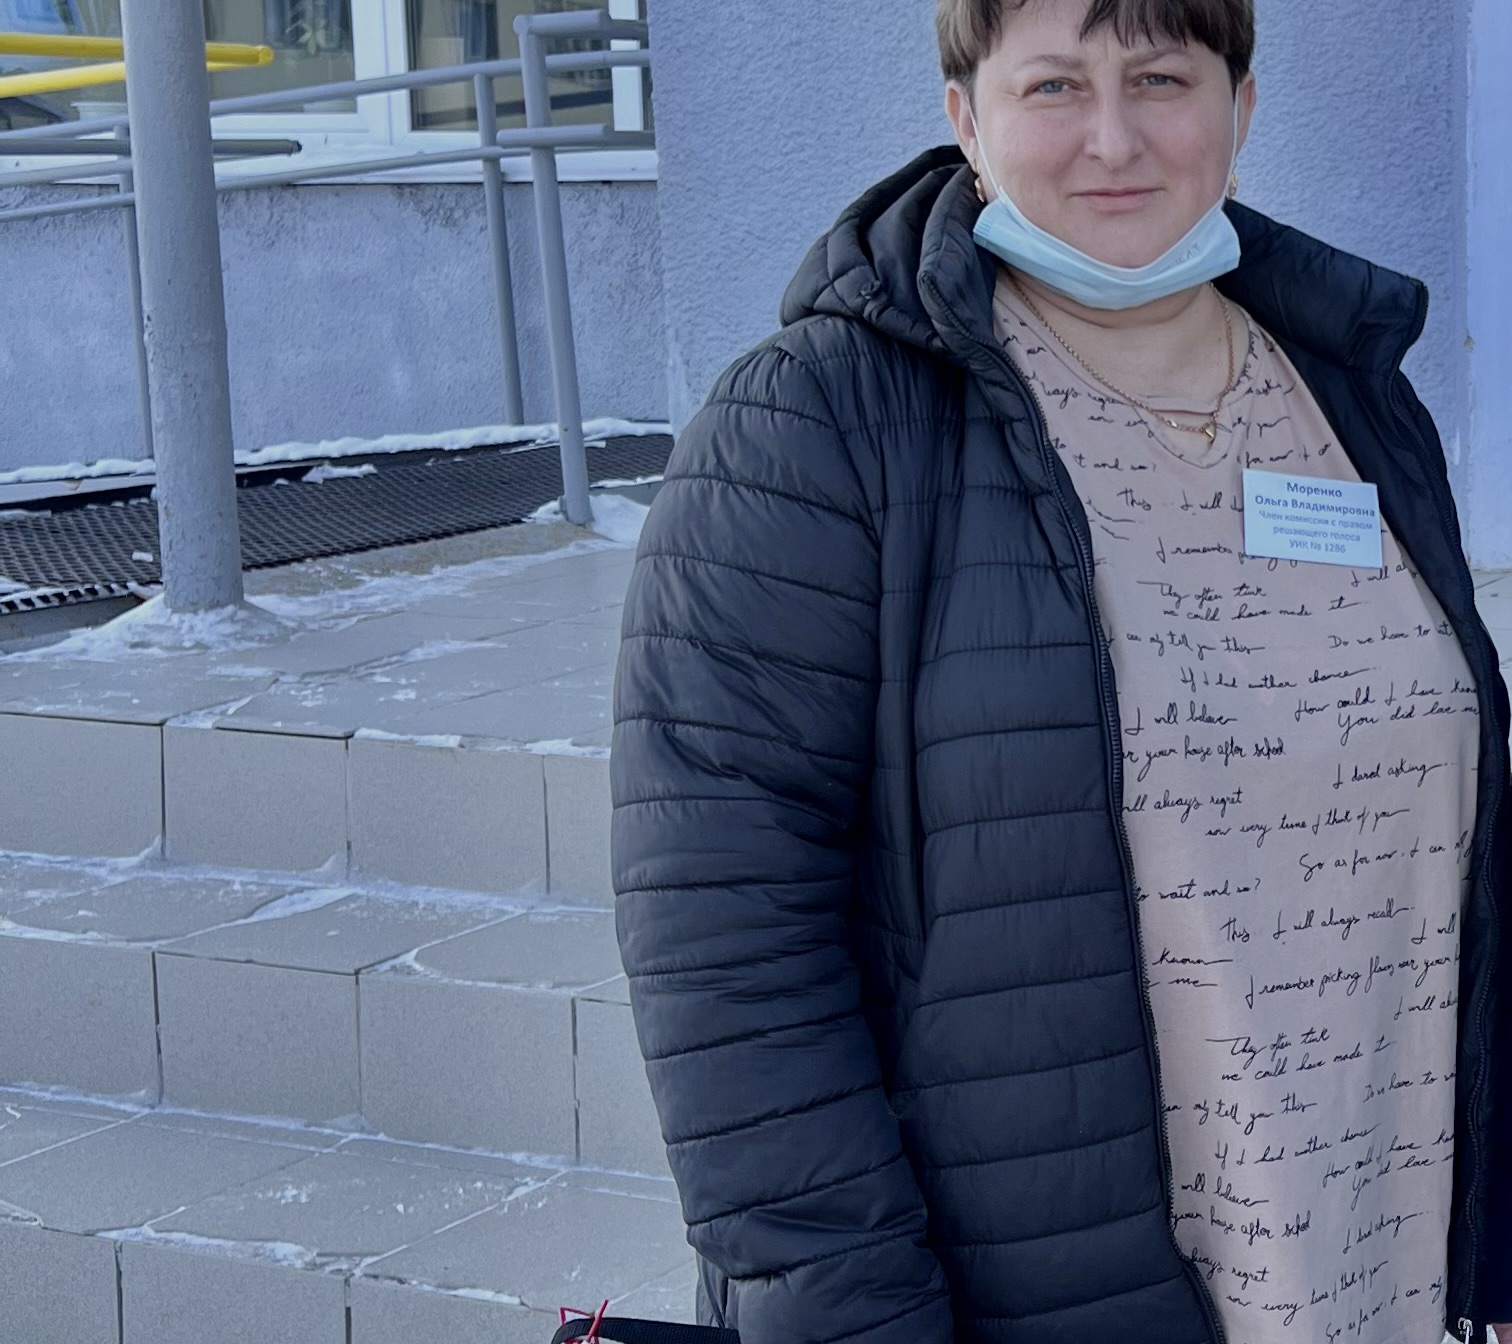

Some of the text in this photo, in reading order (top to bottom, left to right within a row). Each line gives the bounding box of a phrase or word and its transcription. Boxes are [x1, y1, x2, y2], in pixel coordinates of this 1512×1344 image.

[1287, 482, 1343, 498] Моренко
[1255, 495, 1289, 508] Ольга
[1291, 499, 1376, 518] Владимировна
